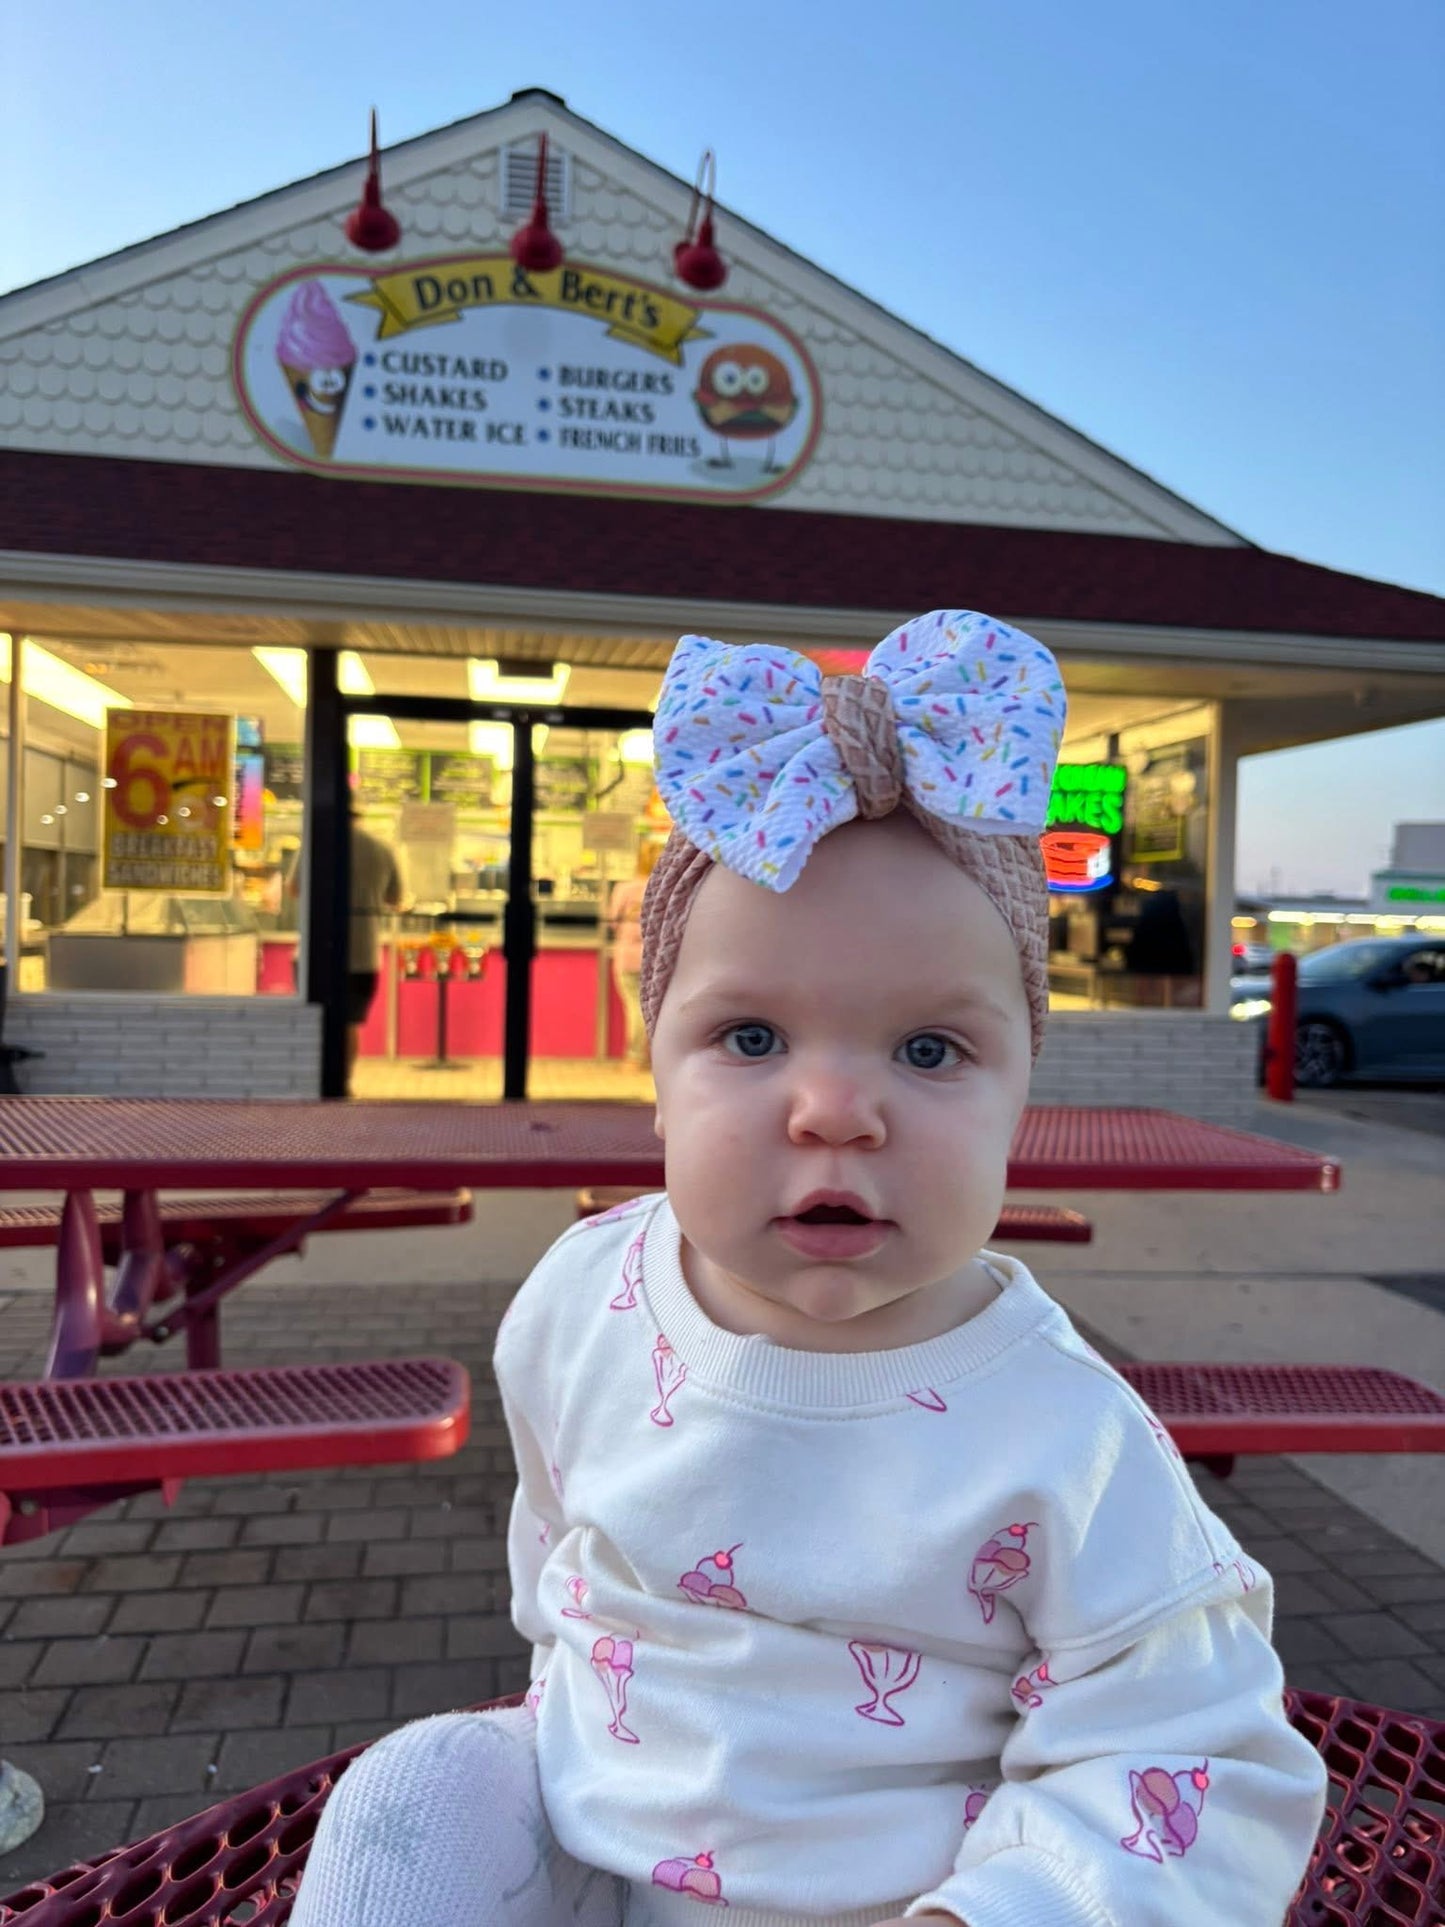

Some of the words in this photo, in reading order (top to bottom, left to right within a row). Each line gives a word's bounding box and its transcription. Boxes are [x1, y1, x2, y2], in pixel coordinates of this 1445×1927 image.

[413, 272, 495, 311] Don
[511, 265, 539, 298] &
[560, 269, 660, 329] Bert's
[381, 350, 509, 382] CUSTARD
[559, 365, 674, 396] BURGERS
[384, 382, 488, 412] SHAKES
[559, 395, 656, 425] STEAKS
[384, 413, 477, 443] WATER
[487, 421, 528, 446] ICE
[559, 426, 642, 455] FRENCH
[648, 432, 702, 459] FRIES
[112, 733, 171, 830] 6
[173, 736, 227, 778] AM
